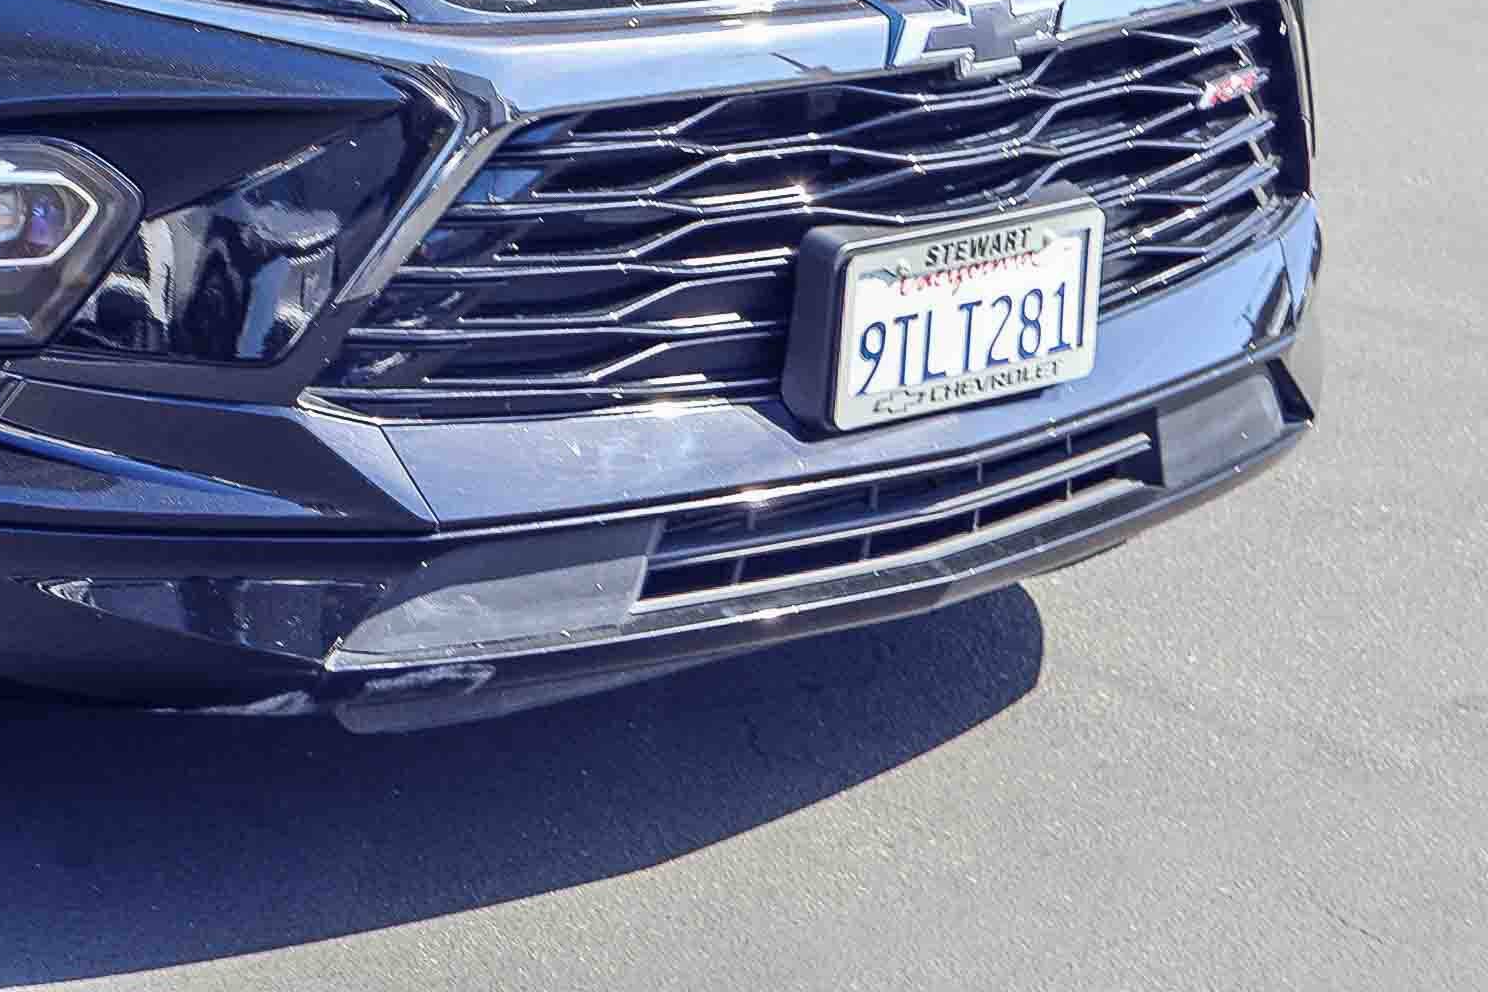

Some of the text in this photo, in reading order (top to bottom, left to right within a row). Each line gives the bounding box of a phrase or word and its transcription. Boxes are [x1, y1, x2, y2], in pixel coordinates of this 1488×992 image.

[925, 227, 1033, 268] STEWART
[854, 281, 1072, 397] 9TLT281
[930, 362, 1062, 402] CHEVROLET
